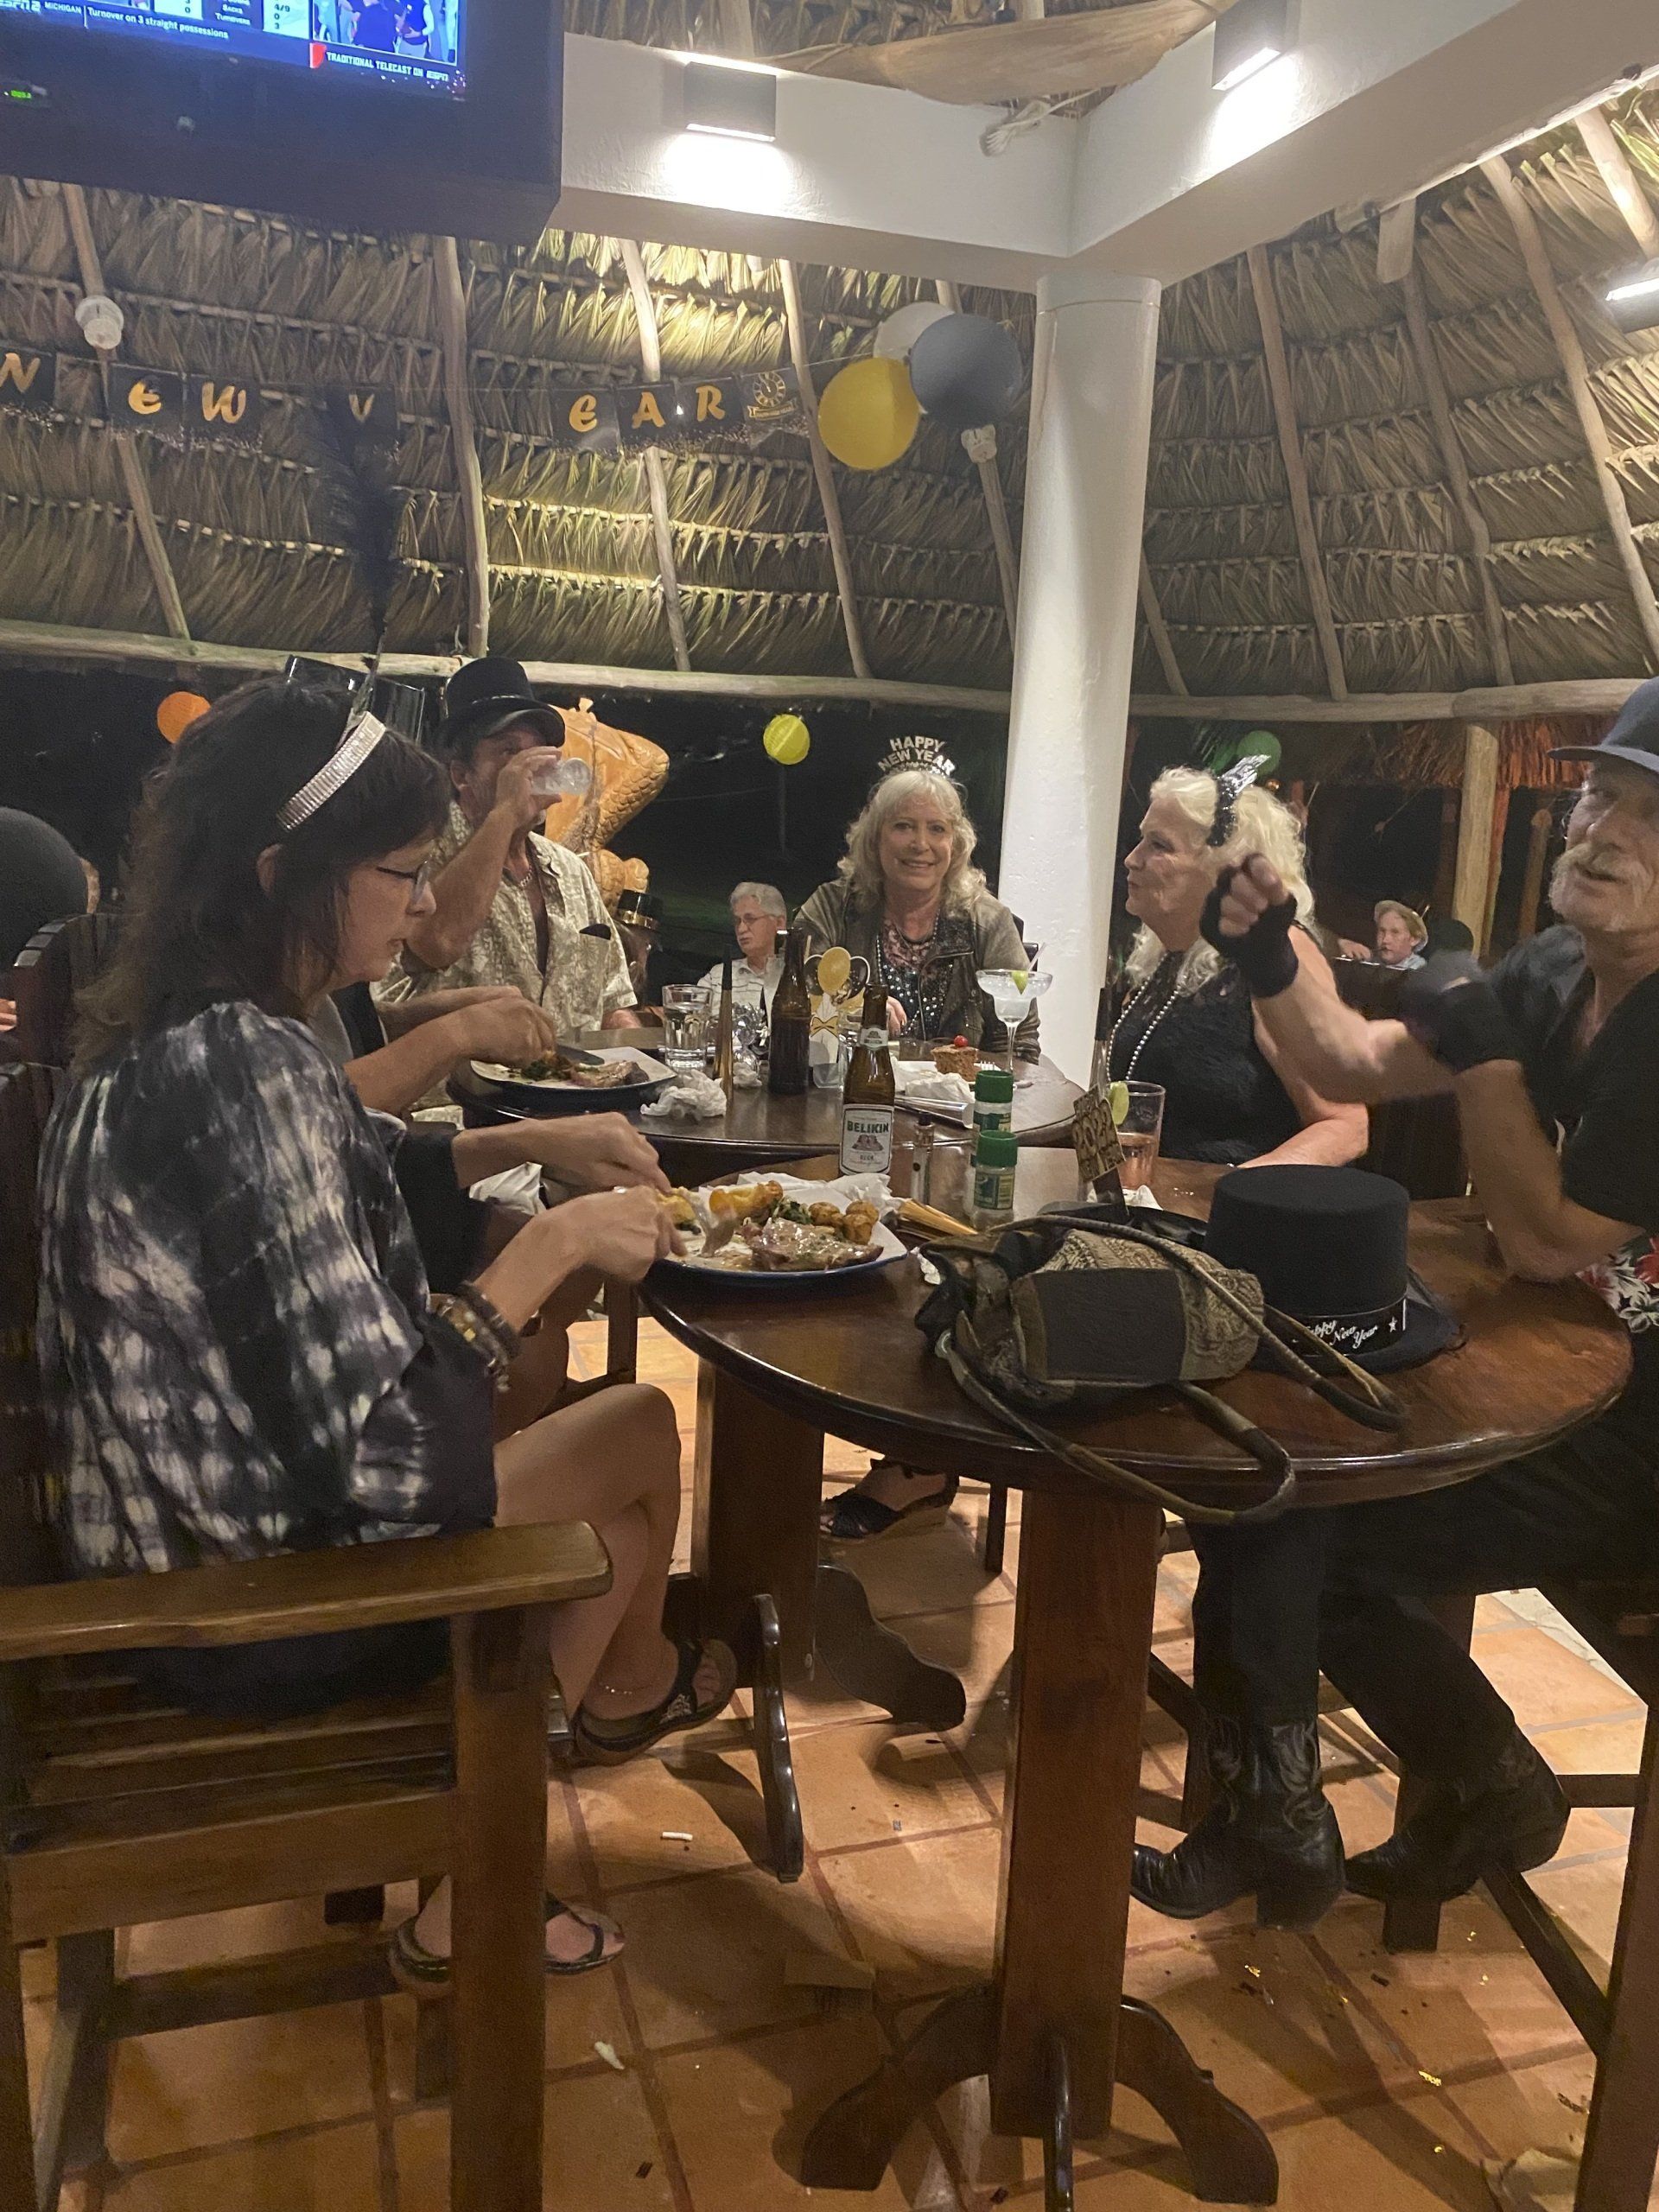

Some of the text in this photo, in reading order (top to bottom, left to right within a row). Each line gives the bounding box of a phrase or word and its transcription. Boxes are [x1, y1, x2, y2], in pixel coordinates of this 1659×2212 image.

[274, 3, 290, 12] 4/9
[45, 1, 82, 14] MICHIGAN
[87, 7, 124, 21] Turnover
[145, 17, 178, 30] straight
[180, 23, 229, 39] possessions
[327, 52, 375, 68] TRADITIONAL
[375, 60, 411, 76] TELECAST
[413, 67, 423, 77] ON
[889, 735, 945, 753] HAPPY
[878, 749, 911, 772] NEW
[847, 1120, 889, 1134] BELIKIN
[1329, 1326, 1357, 1345] New
[1351, 1325, 1379, 1349] Year
